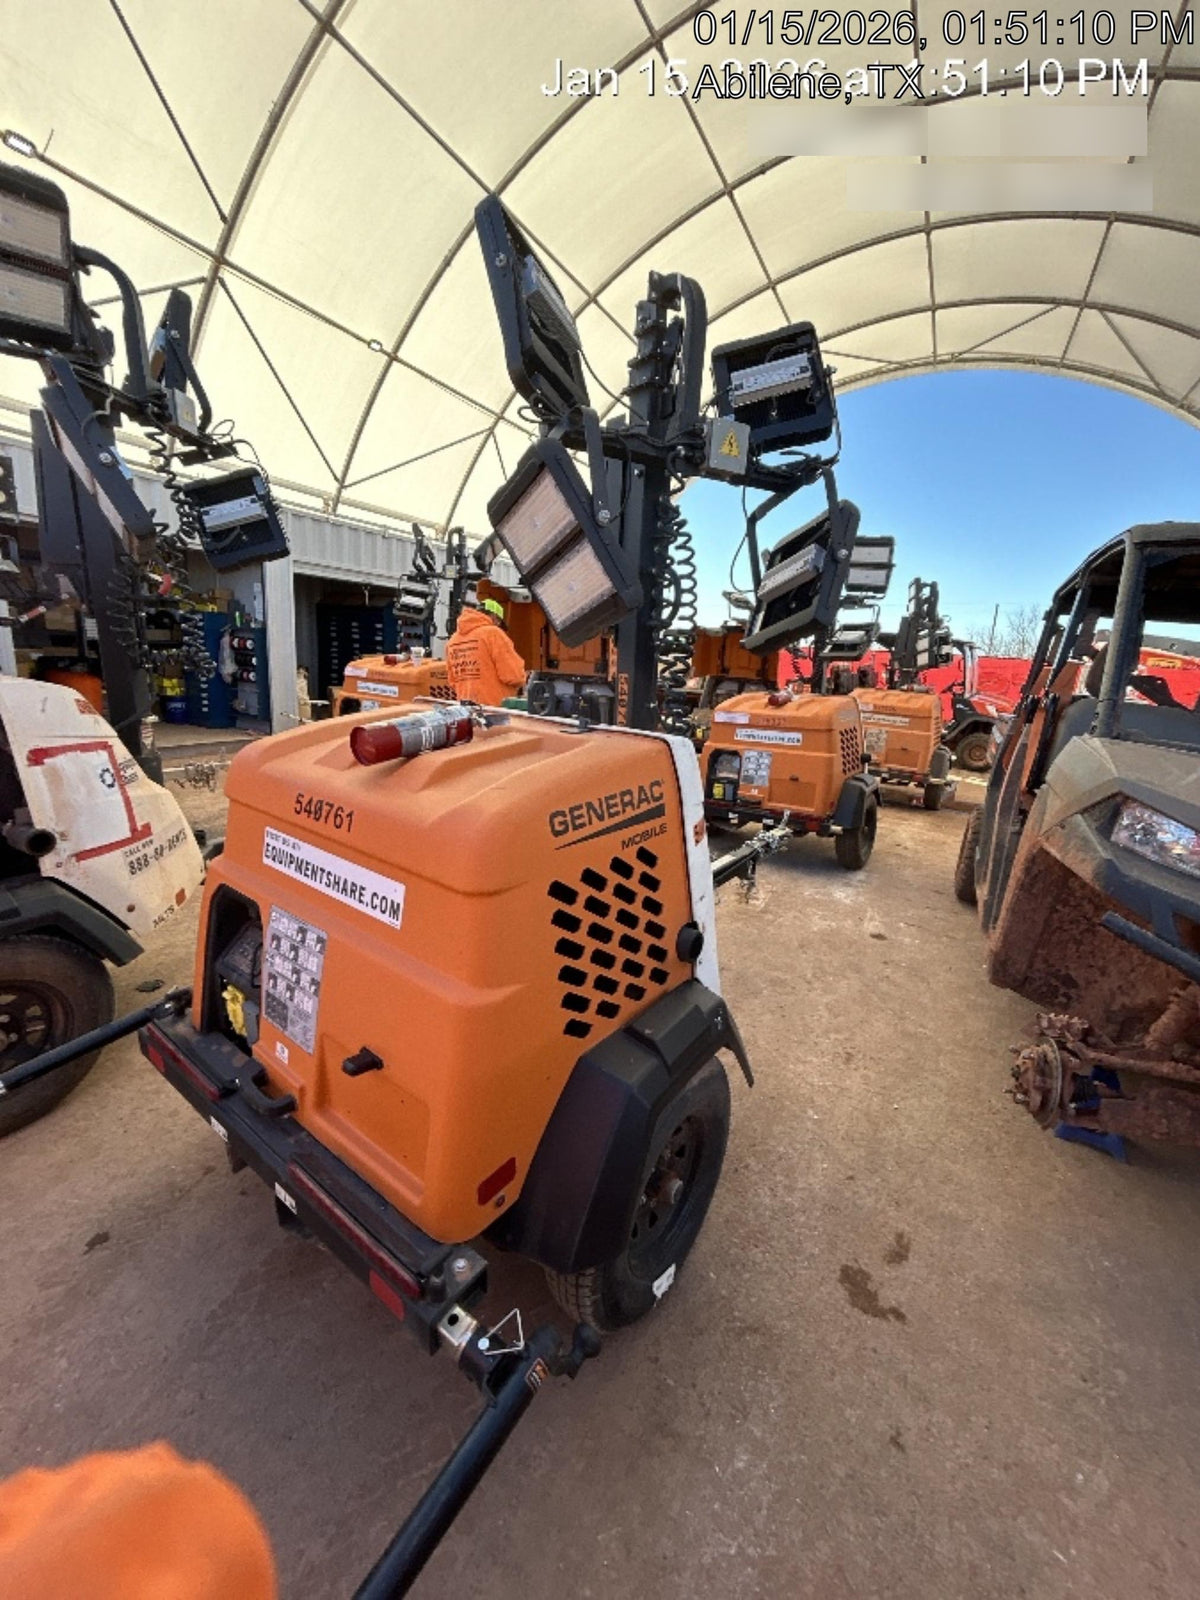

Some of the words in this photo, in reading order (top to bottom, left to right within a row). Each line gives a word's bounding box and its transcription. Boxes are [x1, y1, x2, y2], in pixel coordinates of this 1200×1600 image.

[294, 792, 355, 833] 540761
[549, 780, 664, 839] GENERAC
[621, 822, 667, 851] MOBILE
[265, 842, 401, 922] EQUIPMENTSHARE.COM
